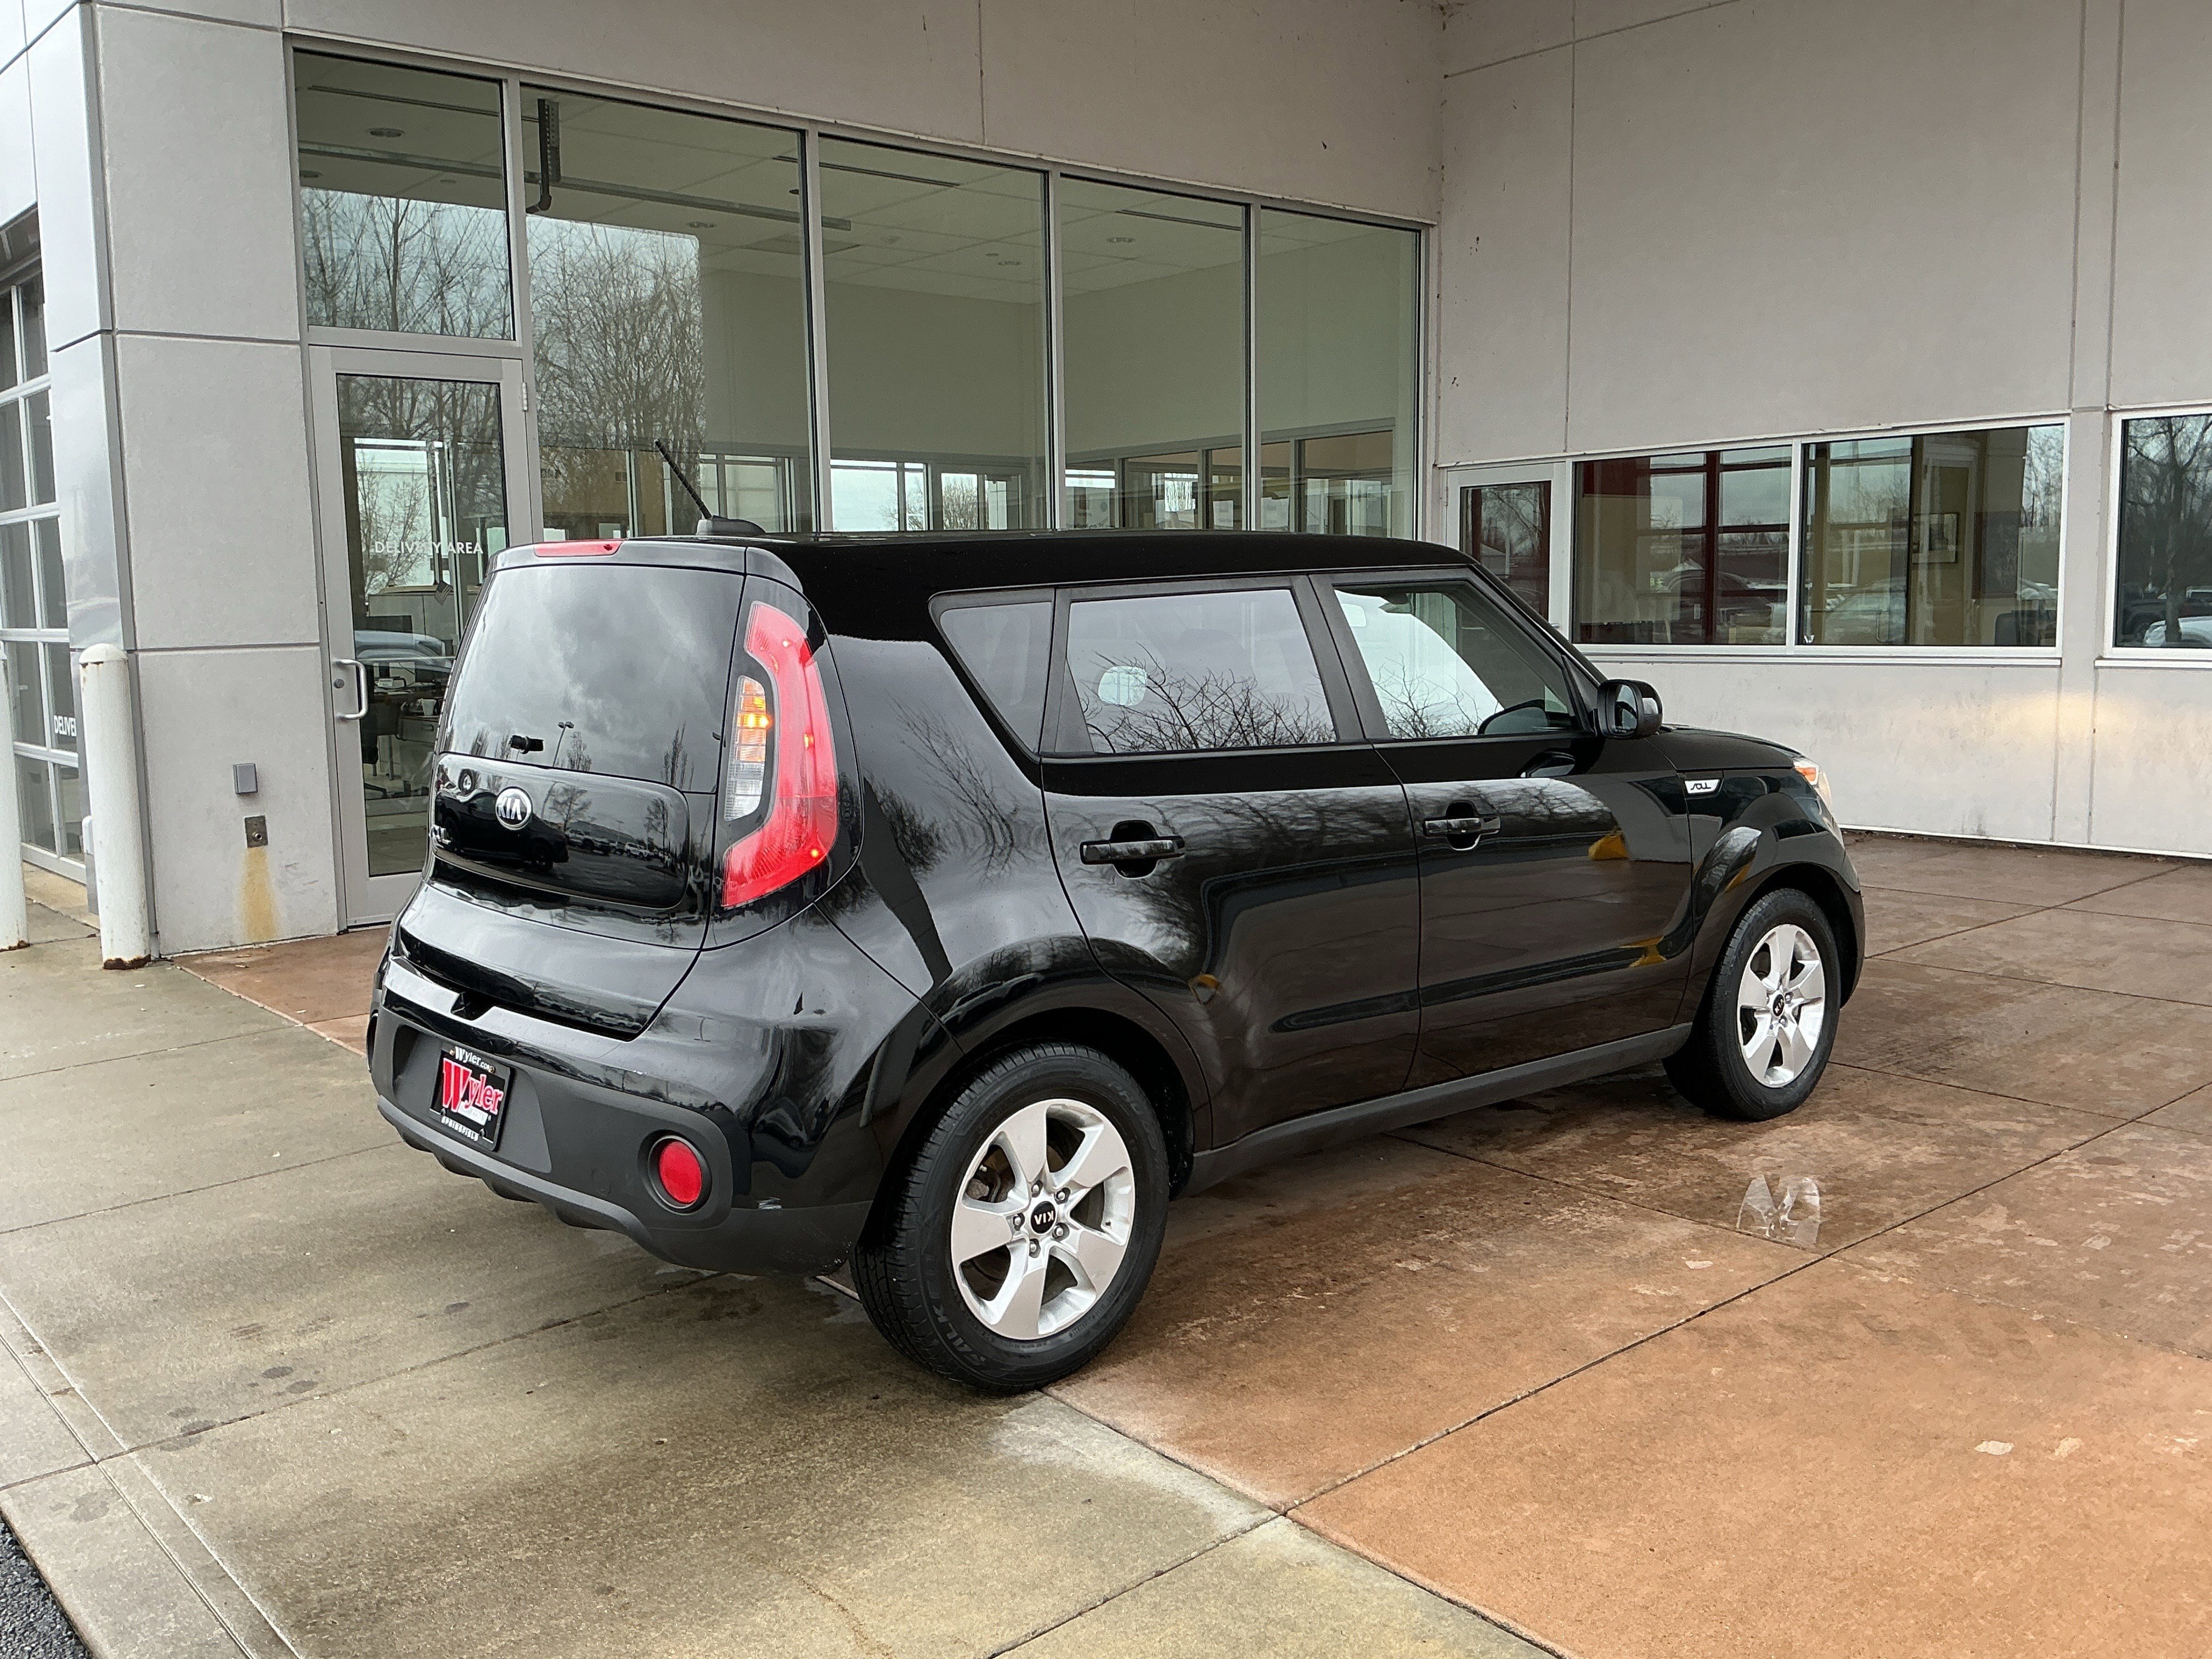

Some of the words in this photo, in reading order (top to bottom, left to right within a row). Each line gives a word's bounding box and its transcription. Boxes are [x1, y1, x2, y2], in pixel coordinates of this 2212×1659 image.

[447, 541, 483, 554] AREA
[498, 797, 522, 820] KIA
[443, 1058, 504, 1115] Wyler
[1034, 1210, 1054, 1225] KIA
